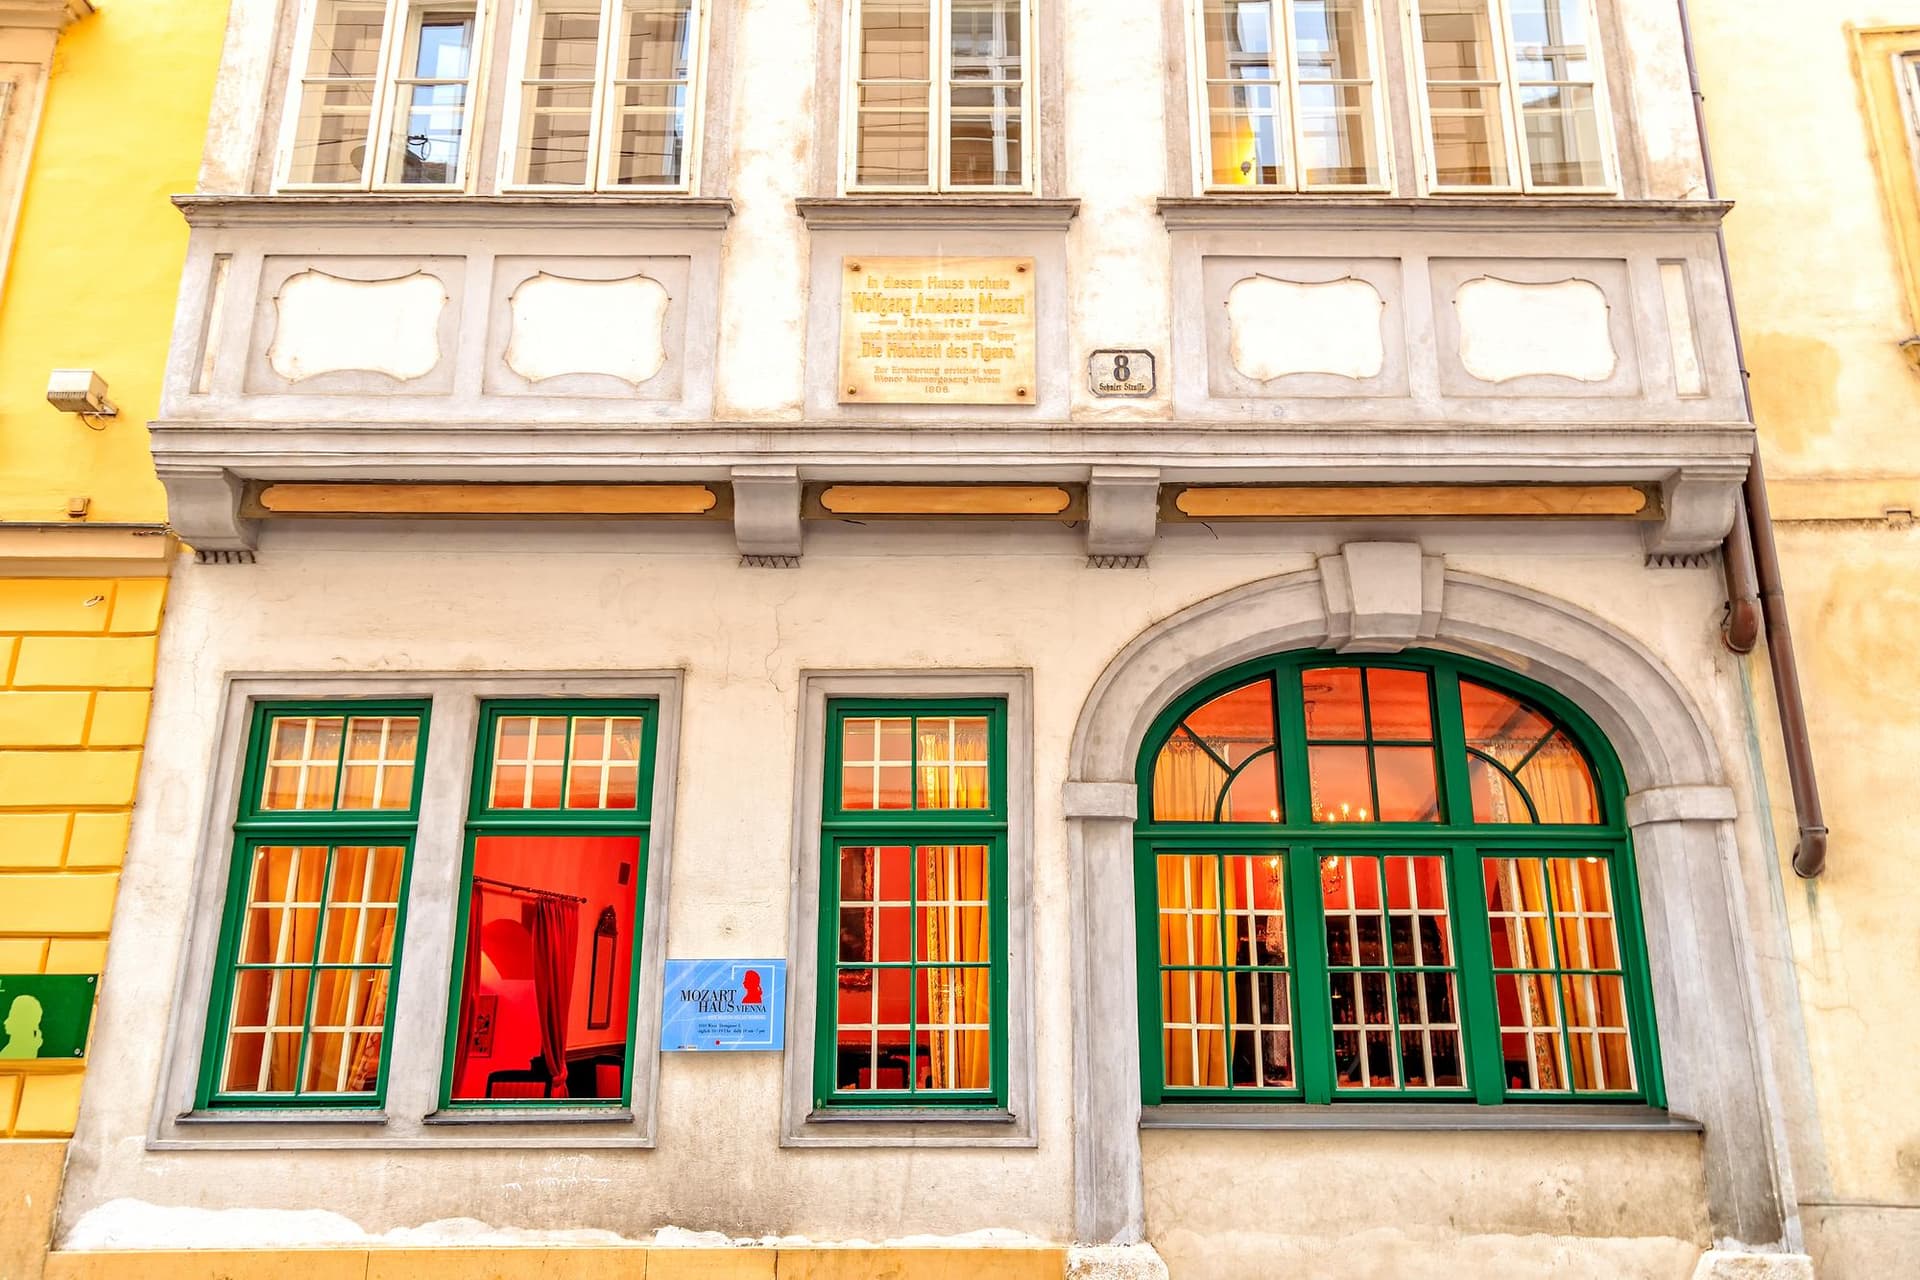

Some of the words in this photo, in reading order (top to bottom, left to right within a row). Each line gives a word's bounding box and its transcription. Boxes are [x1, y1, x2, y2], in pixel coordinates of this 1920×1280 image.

[867, 275, 878, 289] In
[883, 275, 923, 289] diesem
[928, 275, 964, 289] Hause
[969, 276, 1010, 290] wohnte
[851, 291, 912, 317] Wolfgang
[915, 292, 975, 314] Amadeus
[979, 292, 1025, 314] Mozart
[988, 330, 1016, 343] Oper
[886, 342, 941, 359] Hochzeit
[946, 342, 968, 359] des
[1113, 354, 1131, 382] 8
[680, 989, 737, 1002] MOZART
[699, 1000, 735, 1013] HAUS
[737, 1005, 767, 1013] VIENNA
